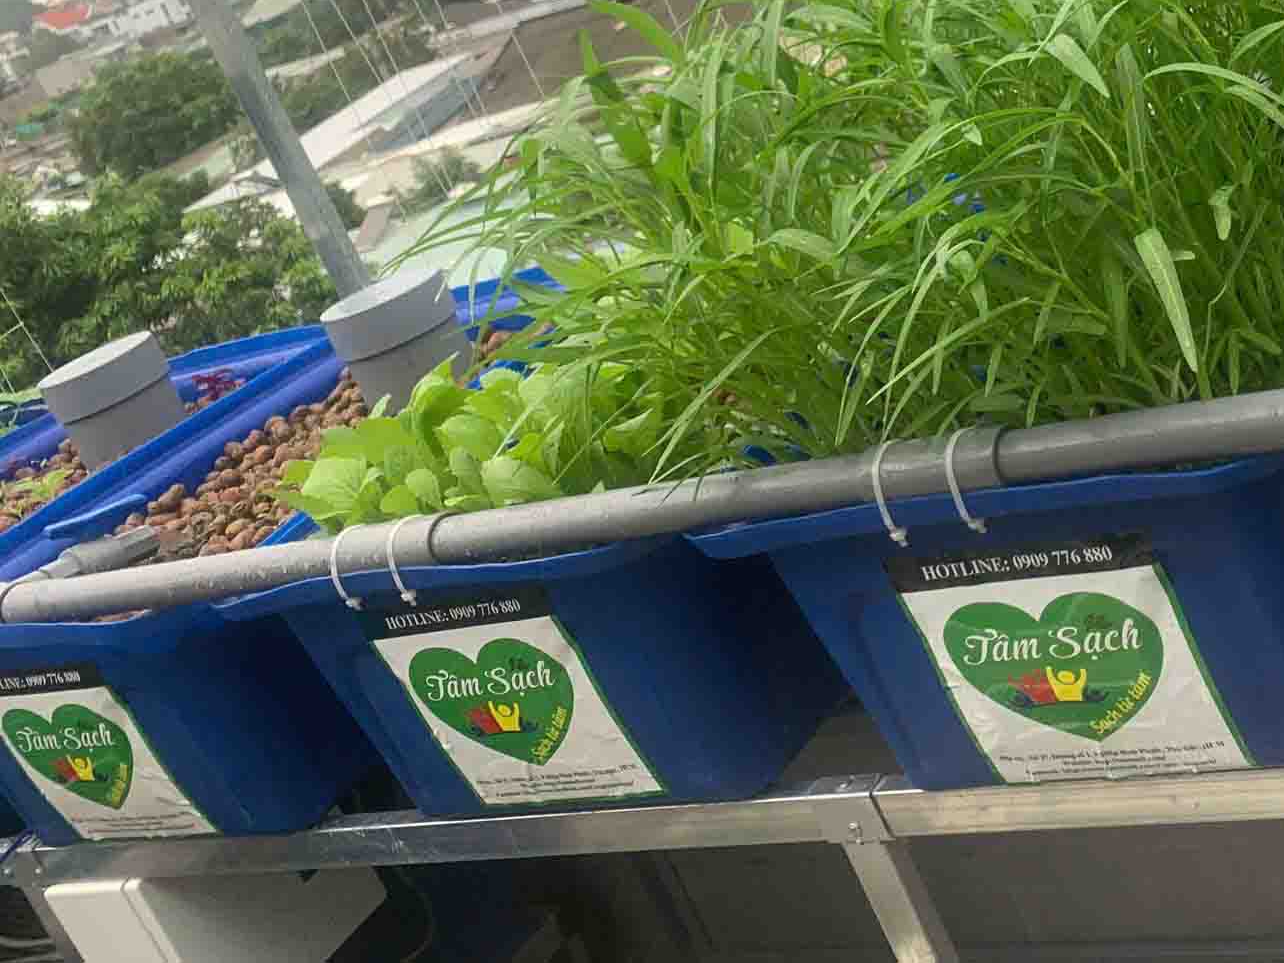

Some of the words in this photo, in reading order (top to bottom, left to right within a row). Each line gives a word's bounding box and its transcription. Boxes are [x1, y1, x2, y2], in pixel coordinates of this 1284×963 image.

[921, 560, 1010, 582] HOTLINE:
[1012, 551, 1050, 569] 0909
[1051, 548, 1081, 566] 776
[1082, 545, 1112, 562] 880
[385, 609, 449, 630] HOTLINE:
[449, 604, 477, 620] 0909
[476, 601, 499, 617] 776
[499, 598, 521, 613] 880
[963, 628, 1042, 666] Tâm
[1048, 617, 1141, 660] Sạch
[425, 669, 483, 701] Tâm
[484, 660, 554, 696] Sạch
